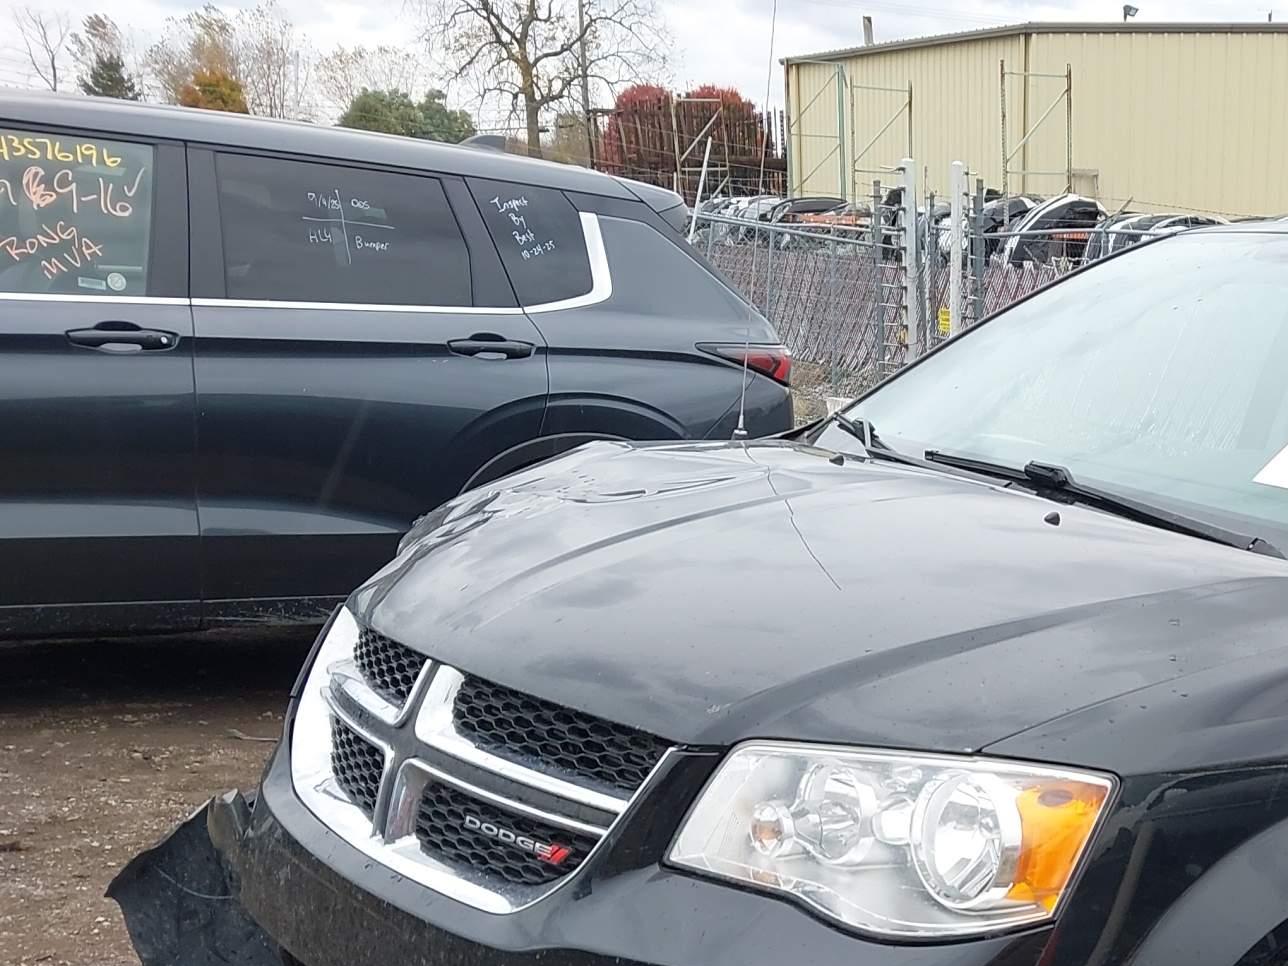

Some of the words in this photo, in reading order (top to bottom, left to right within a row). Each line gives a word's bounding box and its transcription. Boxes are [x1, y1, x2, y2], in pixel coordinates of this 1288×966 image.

[508, 213, 527, 229] By
[41, 237, 104, 279] MVA
[464, 814, 553, 858] DODGE
